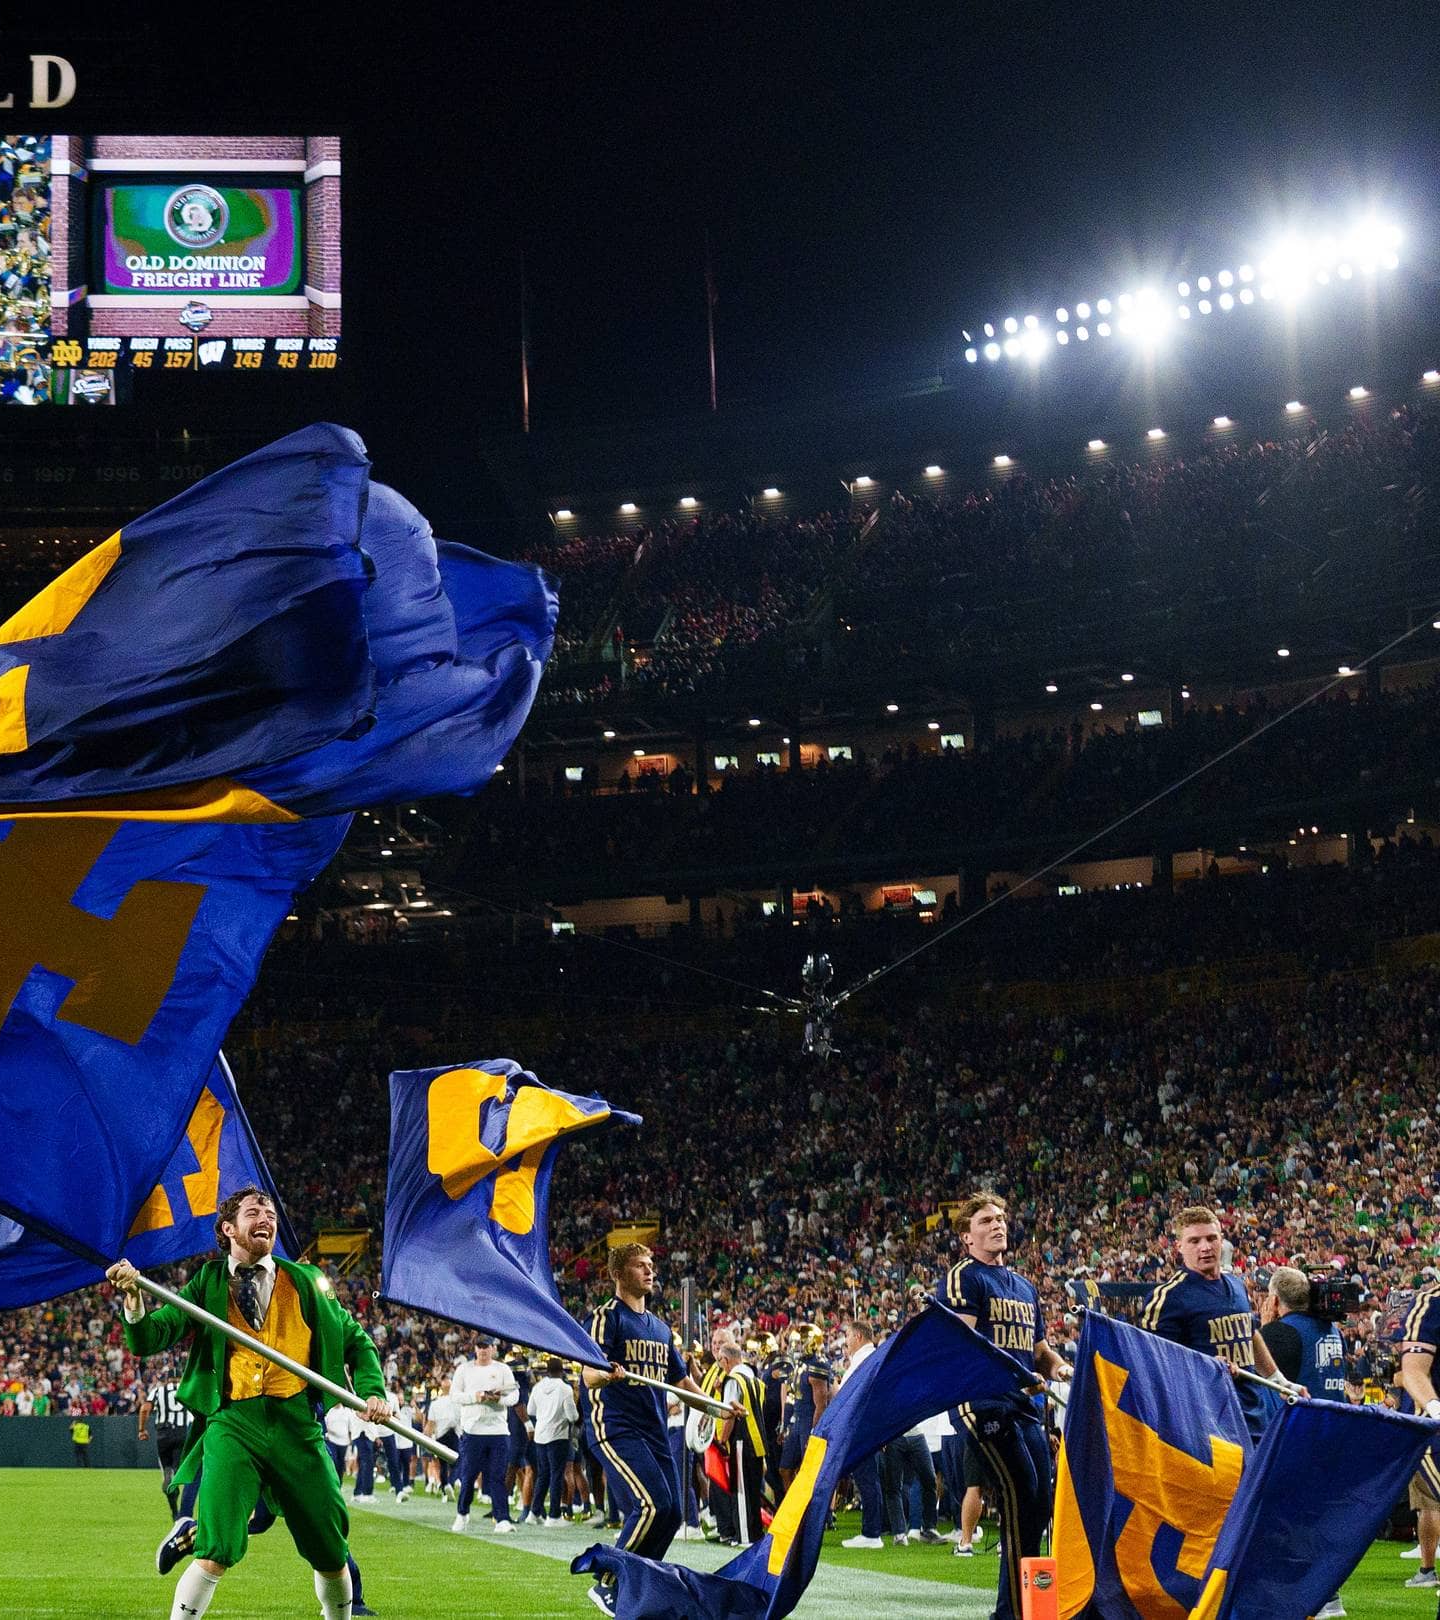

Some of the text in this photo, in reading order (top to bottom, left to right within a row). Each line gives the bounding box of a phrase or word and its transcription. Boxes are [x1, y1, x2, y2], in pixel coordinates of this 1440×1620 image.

[125, 255, 266, 272] OLD DOMINION
[131, 272, 264, 288] FREIGHT LINE
[87, 337, 122, 350] YARDS
[129, 337, 159, 350] RUSH
[163, 337, 193, 350] PASS
[232, 338, 267, 351] YARDS
[274, 338, 304, 351] RUSH
[308, 338, 337, 351] PASS
[87, 351, 117, 368] 202
[132, 351, 154, 368] 45
[163, 351, 193, 368] 157
[233, 352, 263, 368] 143
[277, 352, 299, 368] 43
[308, 352, 337, 369] 100
[33, 466, 76, 483] 1967
[94, 466, 140, 483] 1996
[158, 464, 205, 482] 2010
